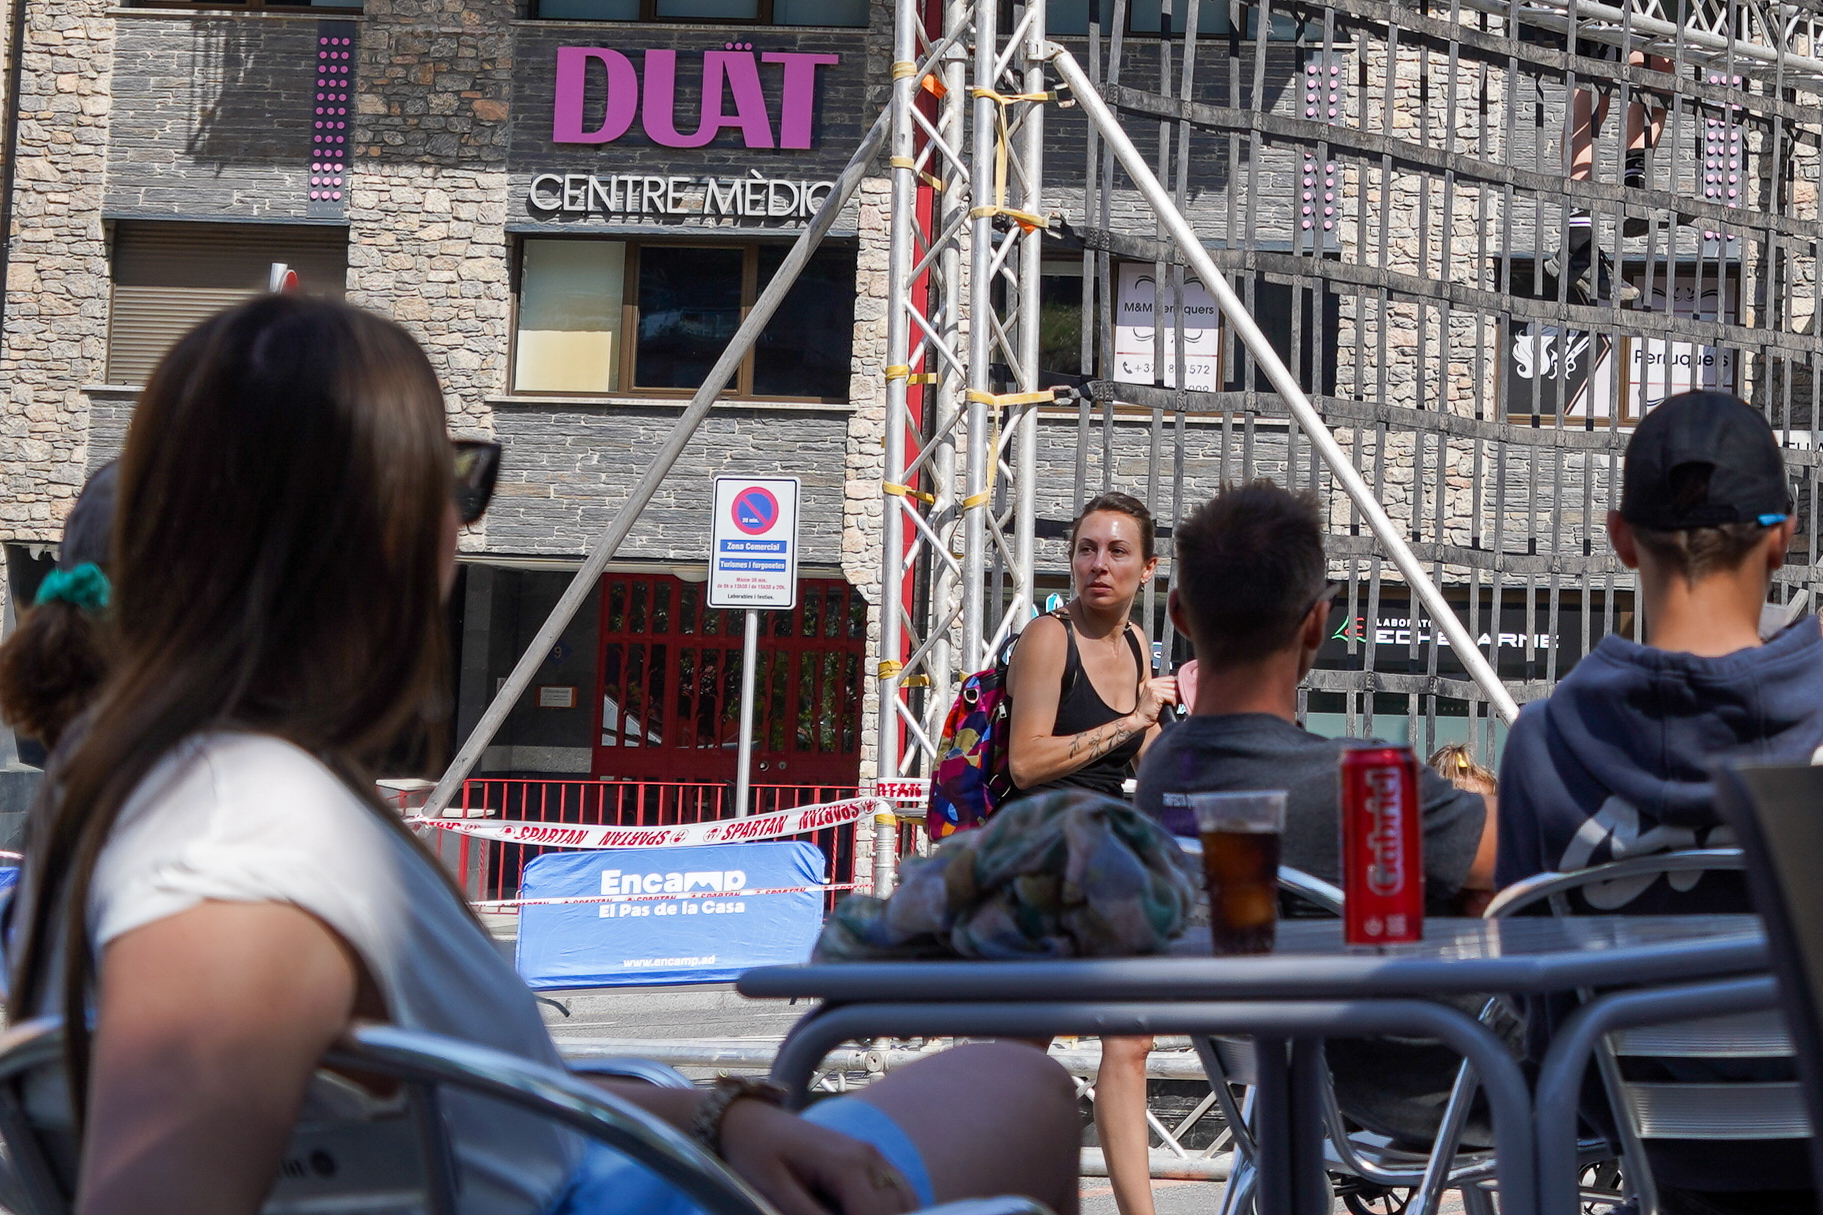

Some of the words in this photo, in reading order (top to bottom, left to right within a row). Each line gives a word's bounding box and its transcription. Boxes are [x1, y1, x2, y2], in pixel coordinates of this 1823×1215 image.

[530, 173, 691, 214] CENTRE
[1124, 303, 1152, 312] M&M
[1634, 349, 1729, 369] Peruques
[726, 542, 744, 550] Zona
[745, 543, 780, 551] Comercial
[1375, 629, 1560, 649] ECHEARNE
[514, 826, 589, 846] SPARTAN
[598, 830, 671, 846] SPARTAN
[721, 815, 789, 841] SPARTAN
[600, 869, 747, 896] Encamp
[599, 904, 615, 918] El
[619, 903, 650, 917] Pas
[654, 902, 677, 916] de
[682, 901, 698, 915] la
[701, 900, 745, 914] Casa
[623, 954, 716, 968] www.encamp.ad
